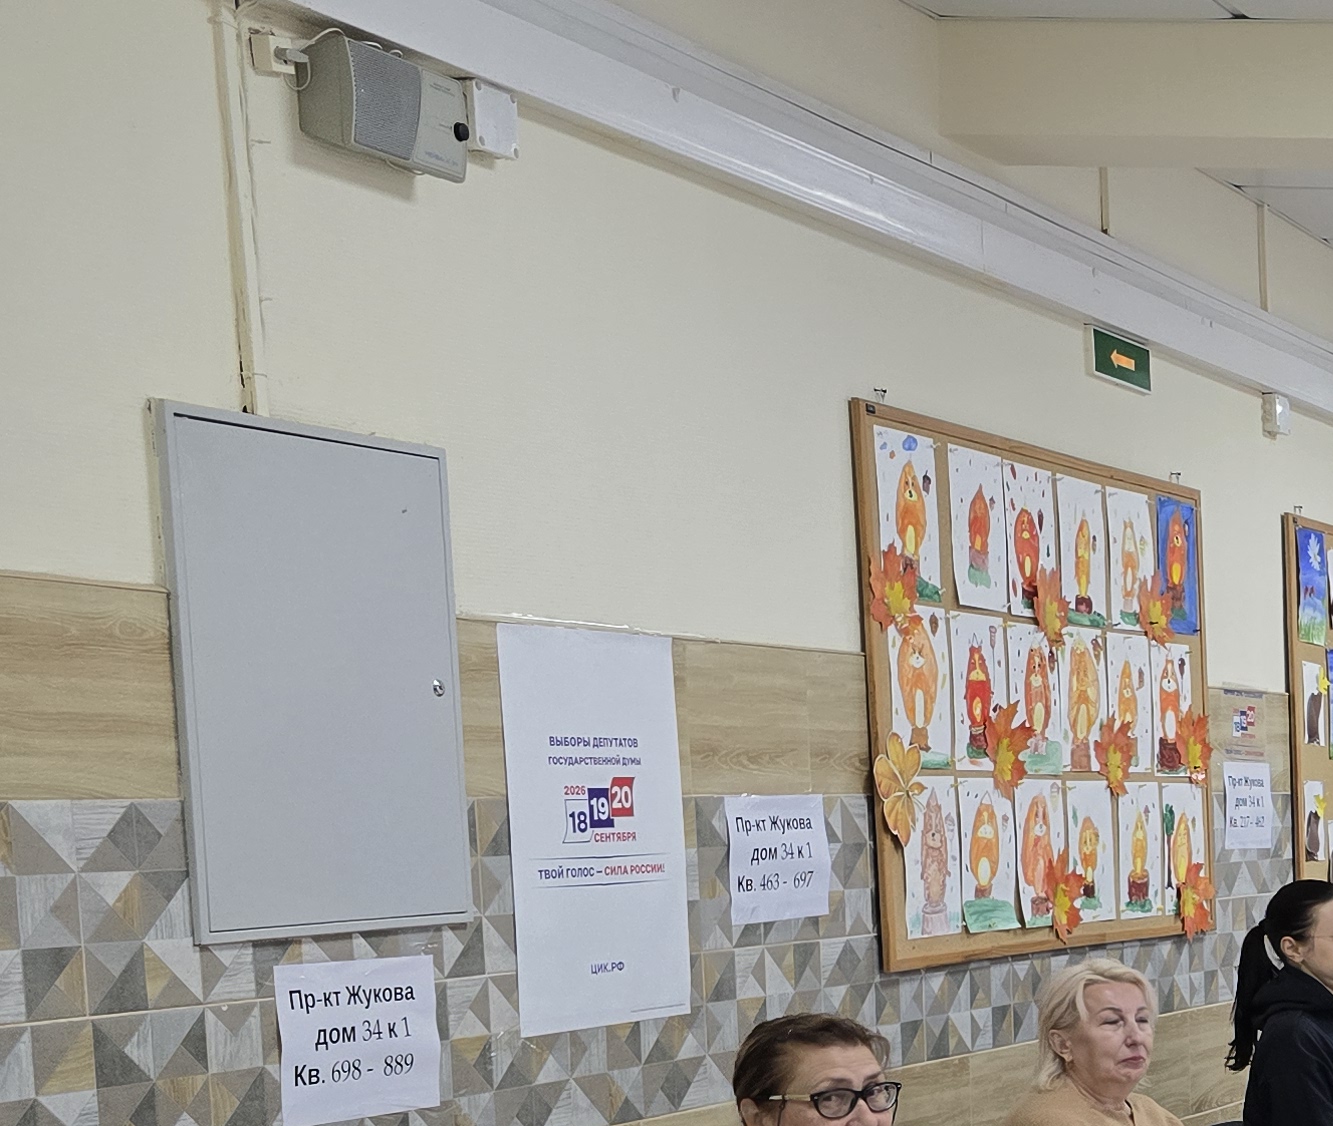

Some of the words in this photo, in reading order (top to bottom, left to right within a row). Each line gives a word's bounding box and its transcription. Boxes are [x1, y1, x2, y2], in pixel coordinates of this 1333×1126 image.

[549, 736, 590, 748] ВЫБОРЫ
[592, 737, 638, 749] ДЕПУТАТОВ
[548, 755, 620, 766] ГОСУДАРСТВЕННОЙ
[621, 756, 641, 767] ДУМЫ
[563, 785, 586, 796] 2026
[611, 785, 632, 808] 20
[590, 797, 608, 821] 19
[569, 810, 588, 834] 18
[735, 815, 767, 836] Пр-кт
[768, 814, 812, 834] Жукова
[594, 831, 637, 843] СЕНТЯБРЯ
[751, 845, 778, 866] дом
[780, 842, 796, 861] 34
[798, 845, 805, 859] к
[806, 842, 813, 859] 1
[538, 866, 564, 880] ТВОЙ
[565, 866, 595, 879] ГОЛОС
[604, 865, 629, 876] СИЛА
[630, 863, 665, 876] РОССИИ!
[737, 875, 757, 893] Кв.
[759, 872, 780, 892] 463
[793, 870, 814, 890] 697
[590, 961, 625, 975] ЦИК.РФ
[289, 988, 342, 1014] Пр-кт
[345, 985, 416, 1009] Жукова
[315, 1025, 357, 1051] дом
[361, 1019, 383, 1042] 34
[388, 1022, 398, 1039] к
[402, 1016, 412, 1037] 1
[294, 1064, 326, 1087] Кв.
[331, 1058, 362, 1082] 698
[383, 1053, 414, 1077] 889
